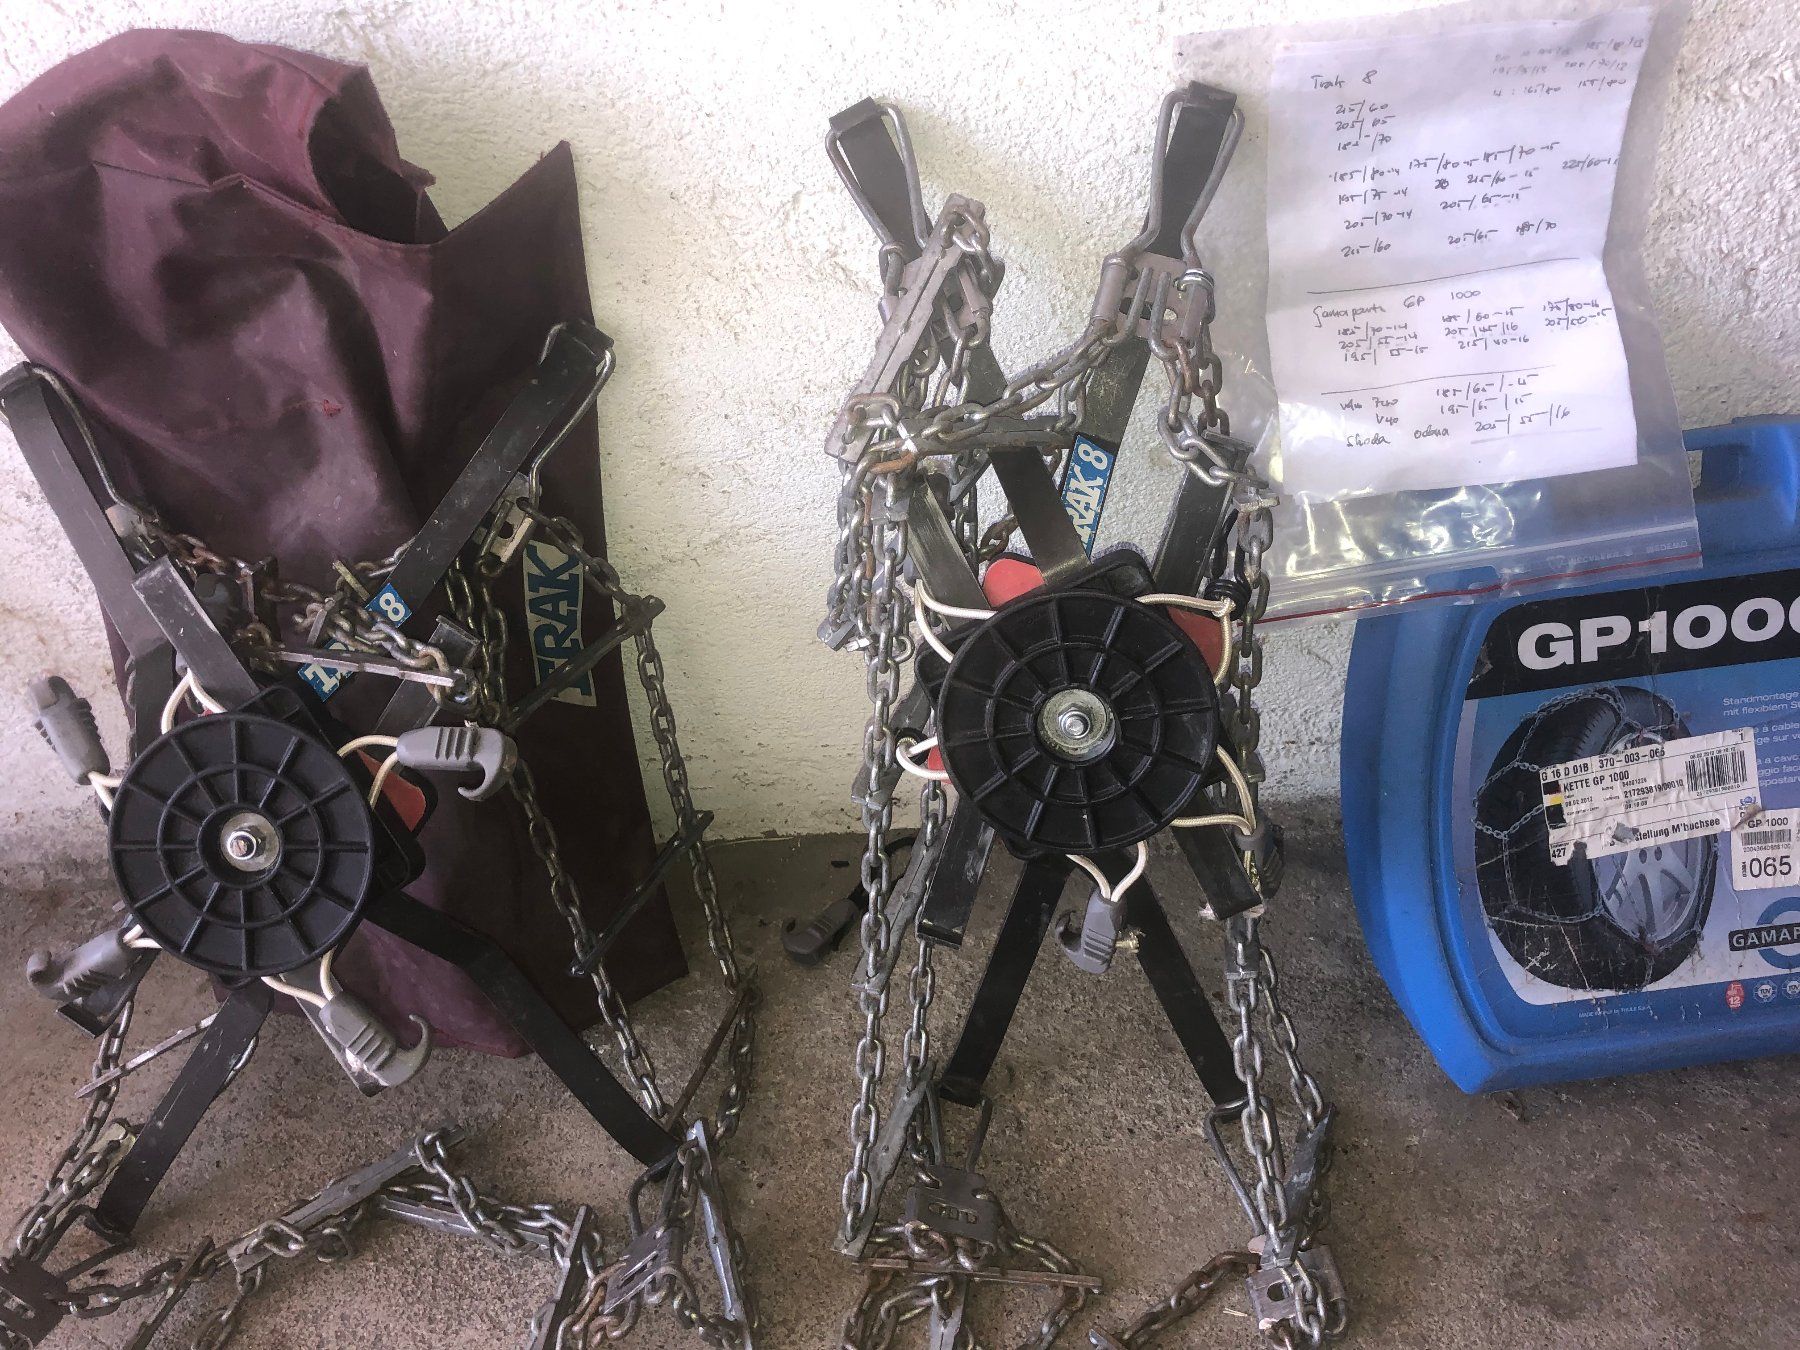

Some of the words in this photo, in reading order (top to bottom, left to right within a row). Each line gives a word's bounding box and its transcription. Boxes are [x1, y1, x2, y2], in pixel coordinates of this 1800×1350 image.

[1362, 70, 1377, 84] 8
[1451, 290, 1481, 300] 1000
[1078, 443, 1108, 470] 8
[379, 592, 406, 622] 8
[1517, 596, 1800, 671] GP100
[1563, 779, 1591, 793] KETTE
[1593, 775, 1606, 786] GP
[1609, 770, 1630, 783] 1000
[1748, 819, 1763, 829] GP
[1765, 817, 1789, 827] 1000
[1551, 847, 1567, 859] 427
[1749, 855, 1792, 879] 065
